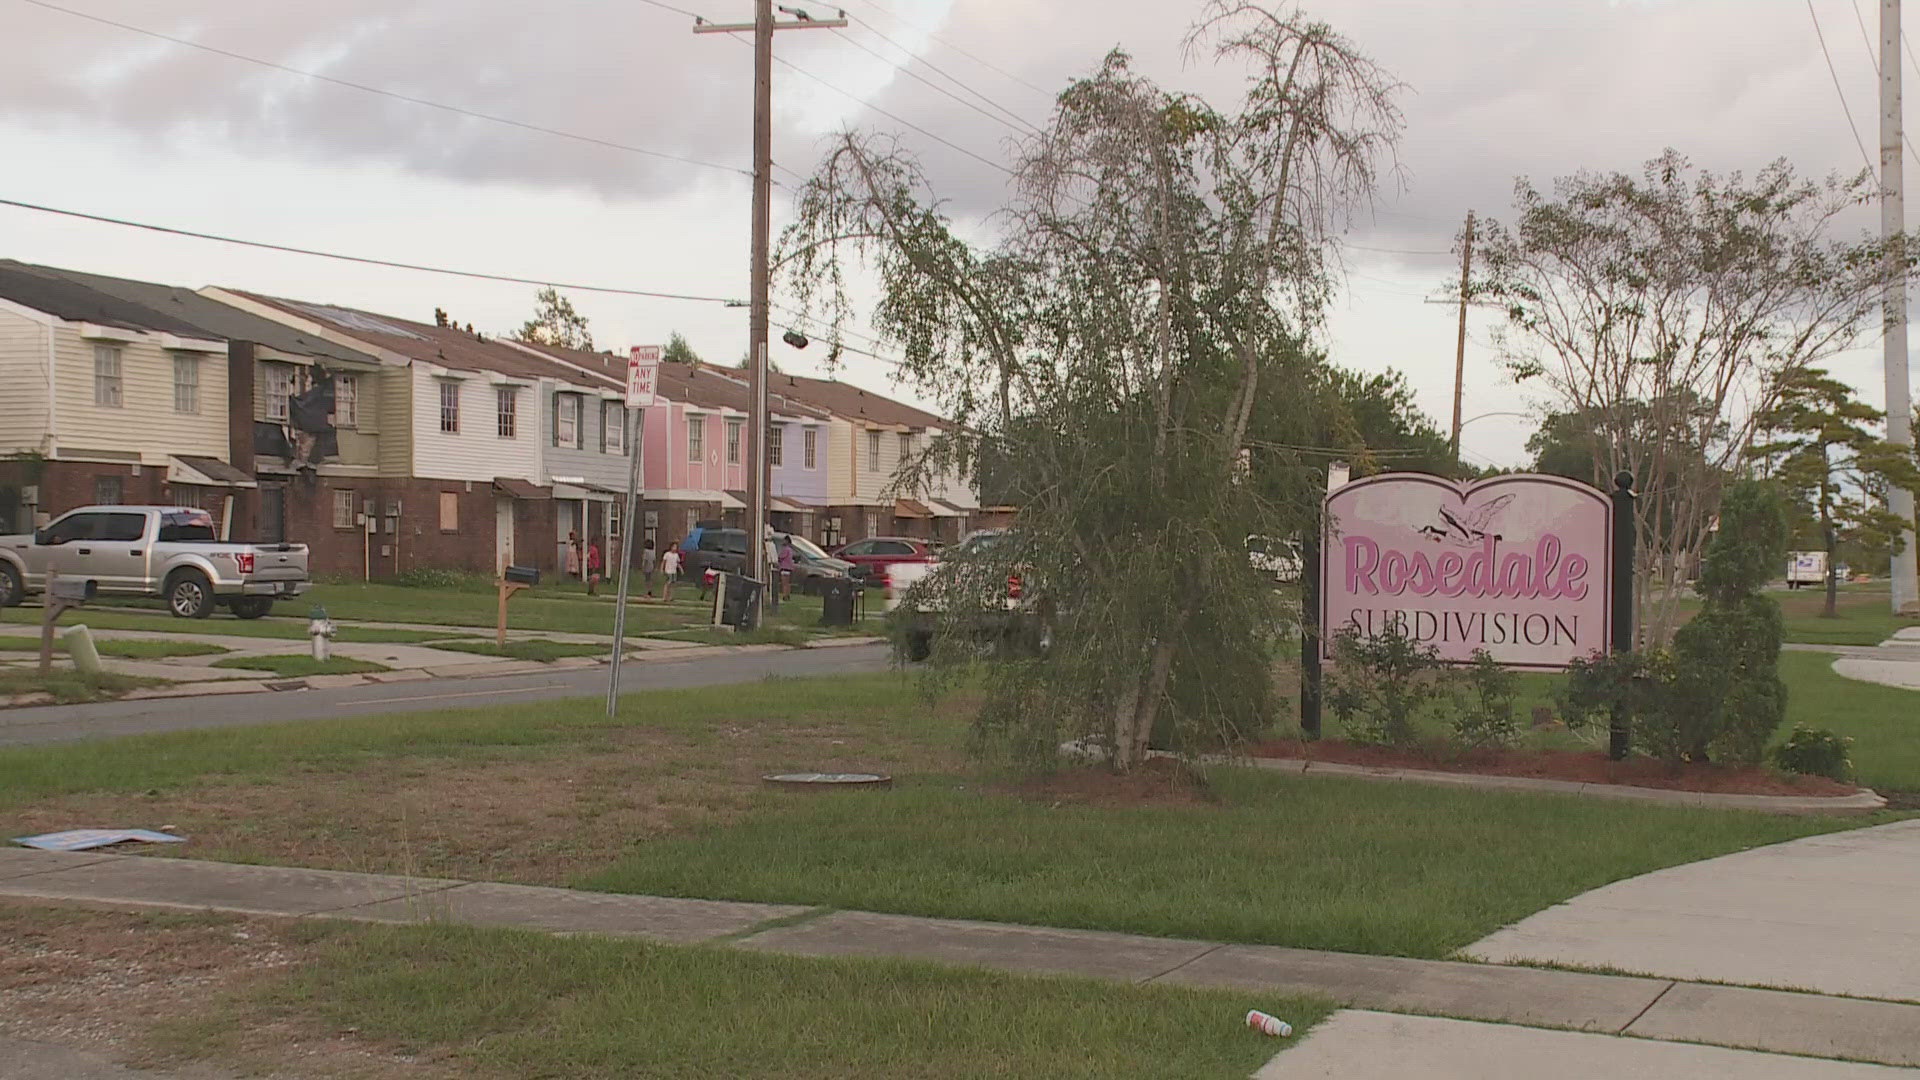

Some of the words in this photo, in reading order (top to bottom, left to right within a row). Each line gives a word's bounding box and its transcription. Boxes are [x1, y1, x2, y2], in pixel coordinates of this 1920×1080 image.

[635, 368, 651, 378] ANY
[633, 382, 651, 394] TIME
[1343, 533, 1588, 601] Rosedale
[1350, 608, 1578, 647] SUBDIVISION
